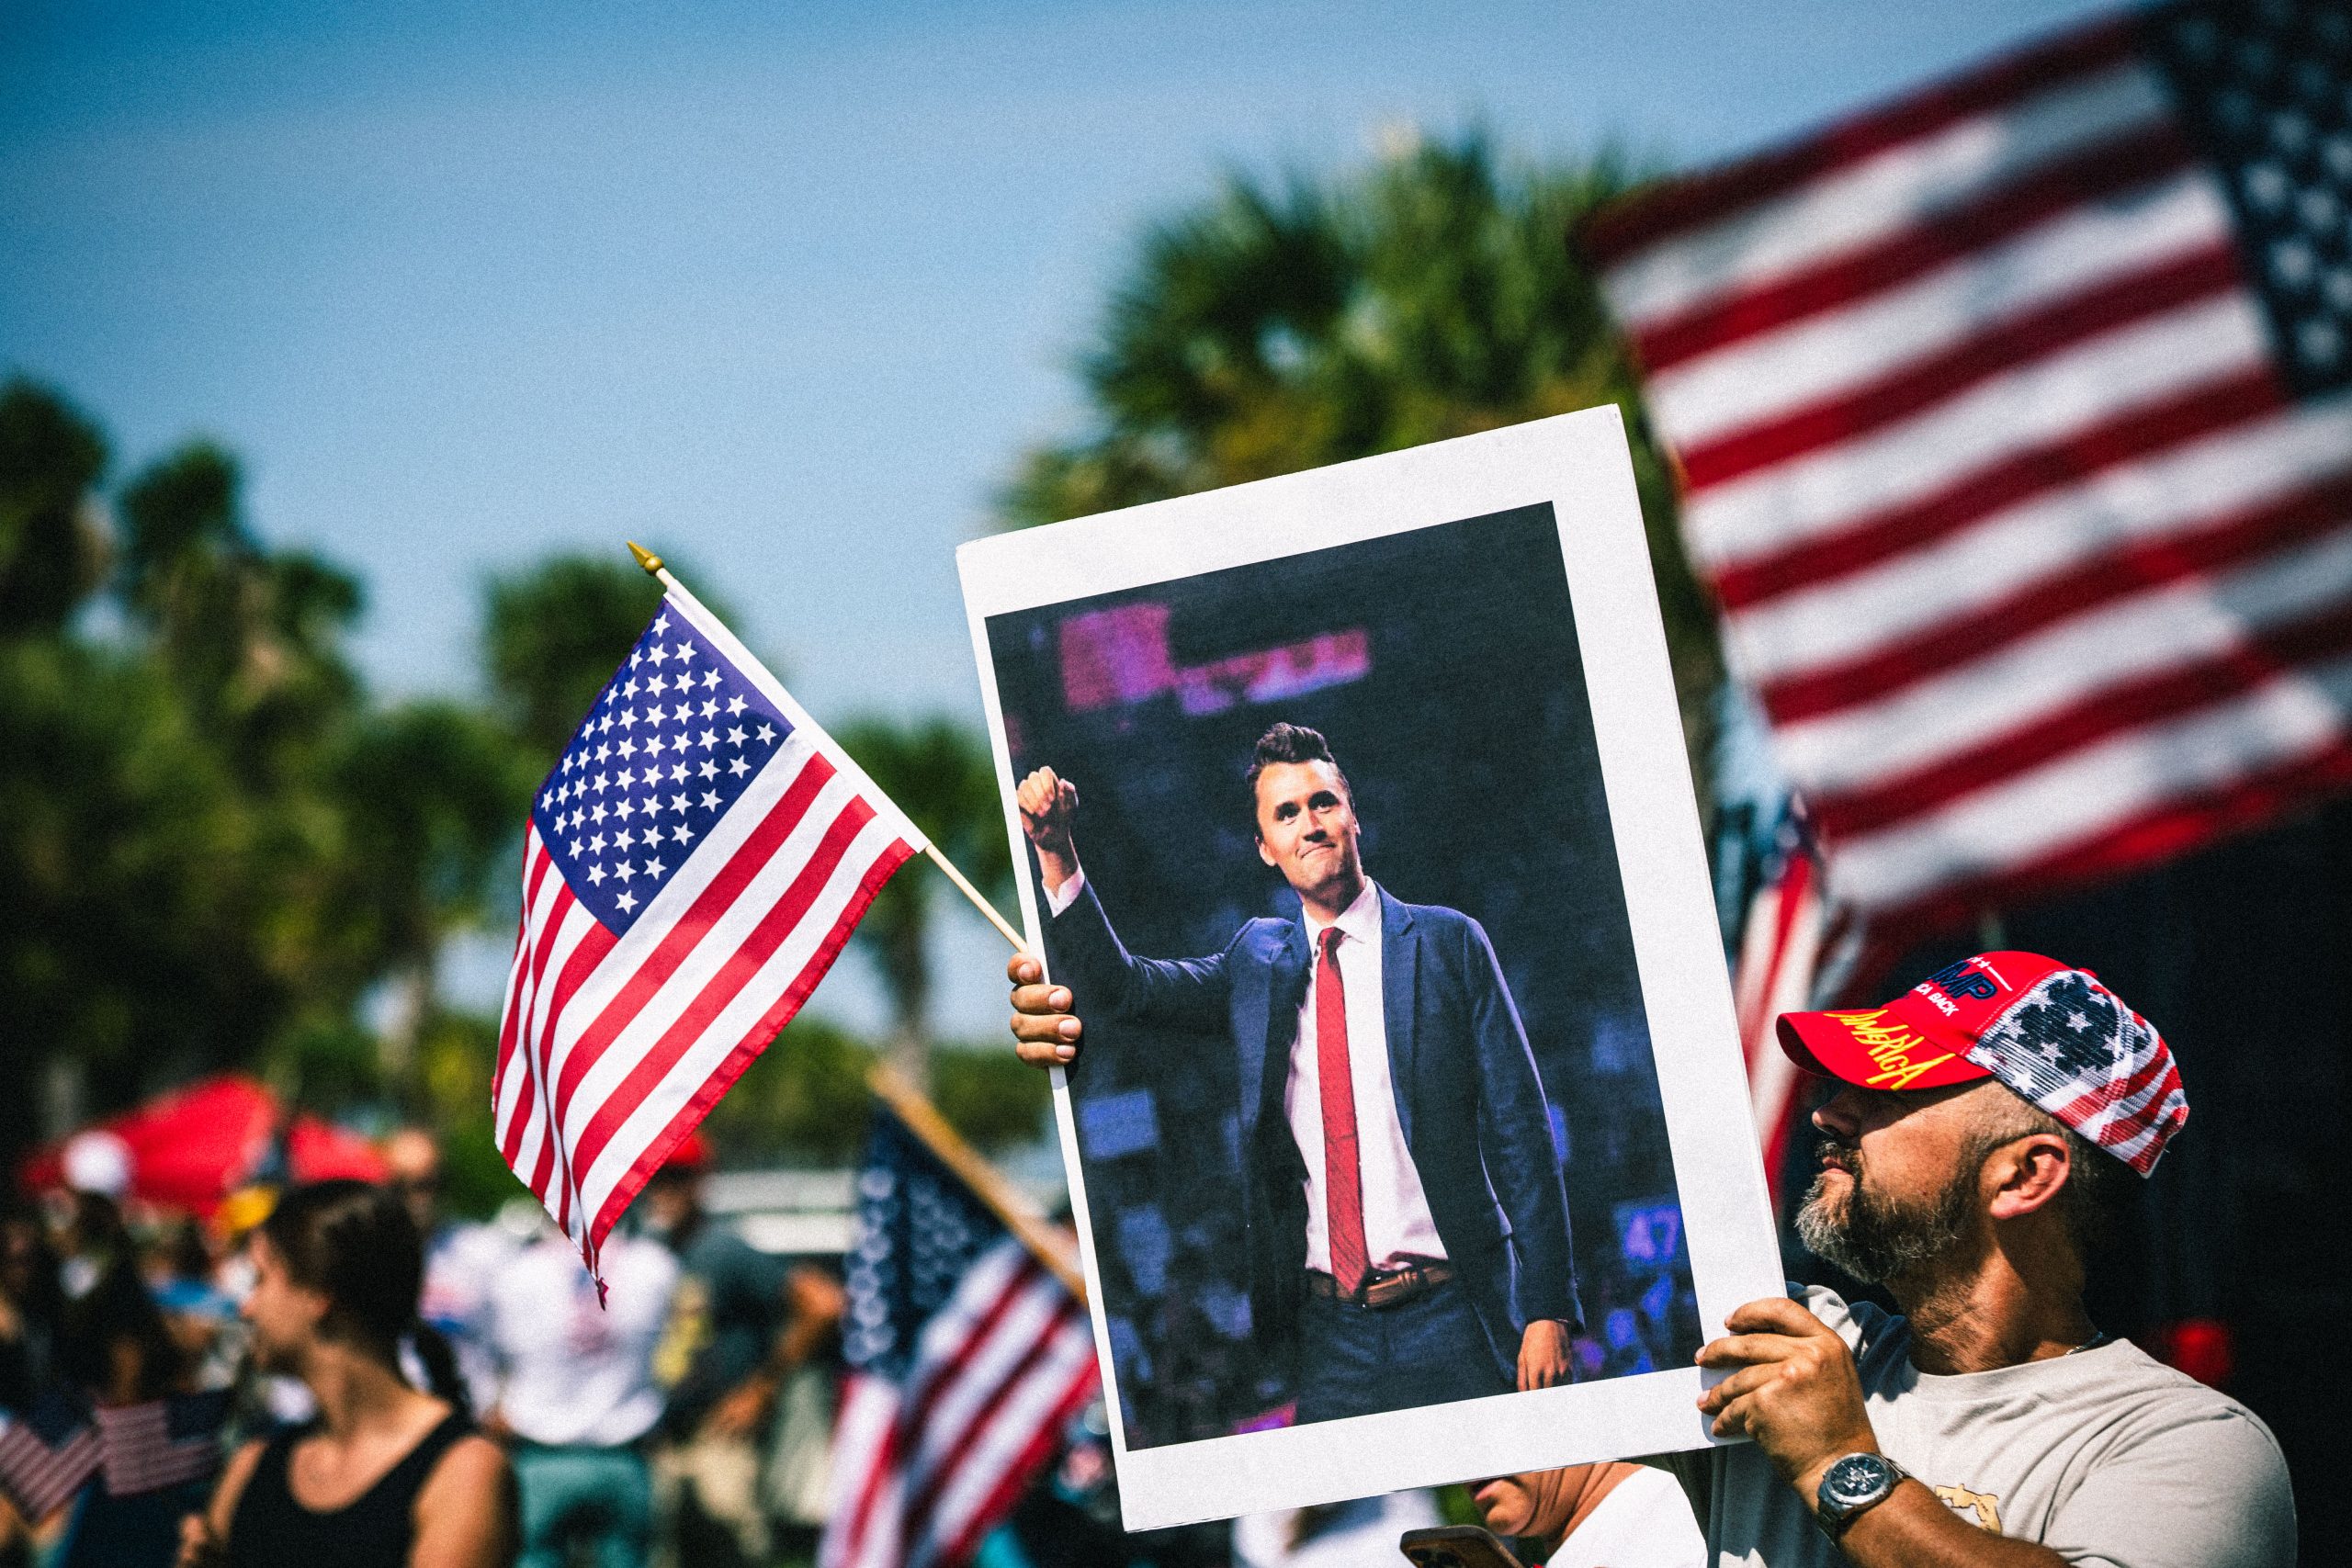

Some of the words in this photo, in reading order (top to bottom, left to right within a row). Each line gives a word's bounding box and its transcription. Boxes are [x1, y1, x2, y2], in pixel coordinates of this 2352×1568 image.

[1926, 959, 1998, 1000] MP
[1927, 992, 1960, 1017] BACK
[1823, 1010, 1956, 1091] AMERICA
[1623, 1208, 1680, 1261] 47
